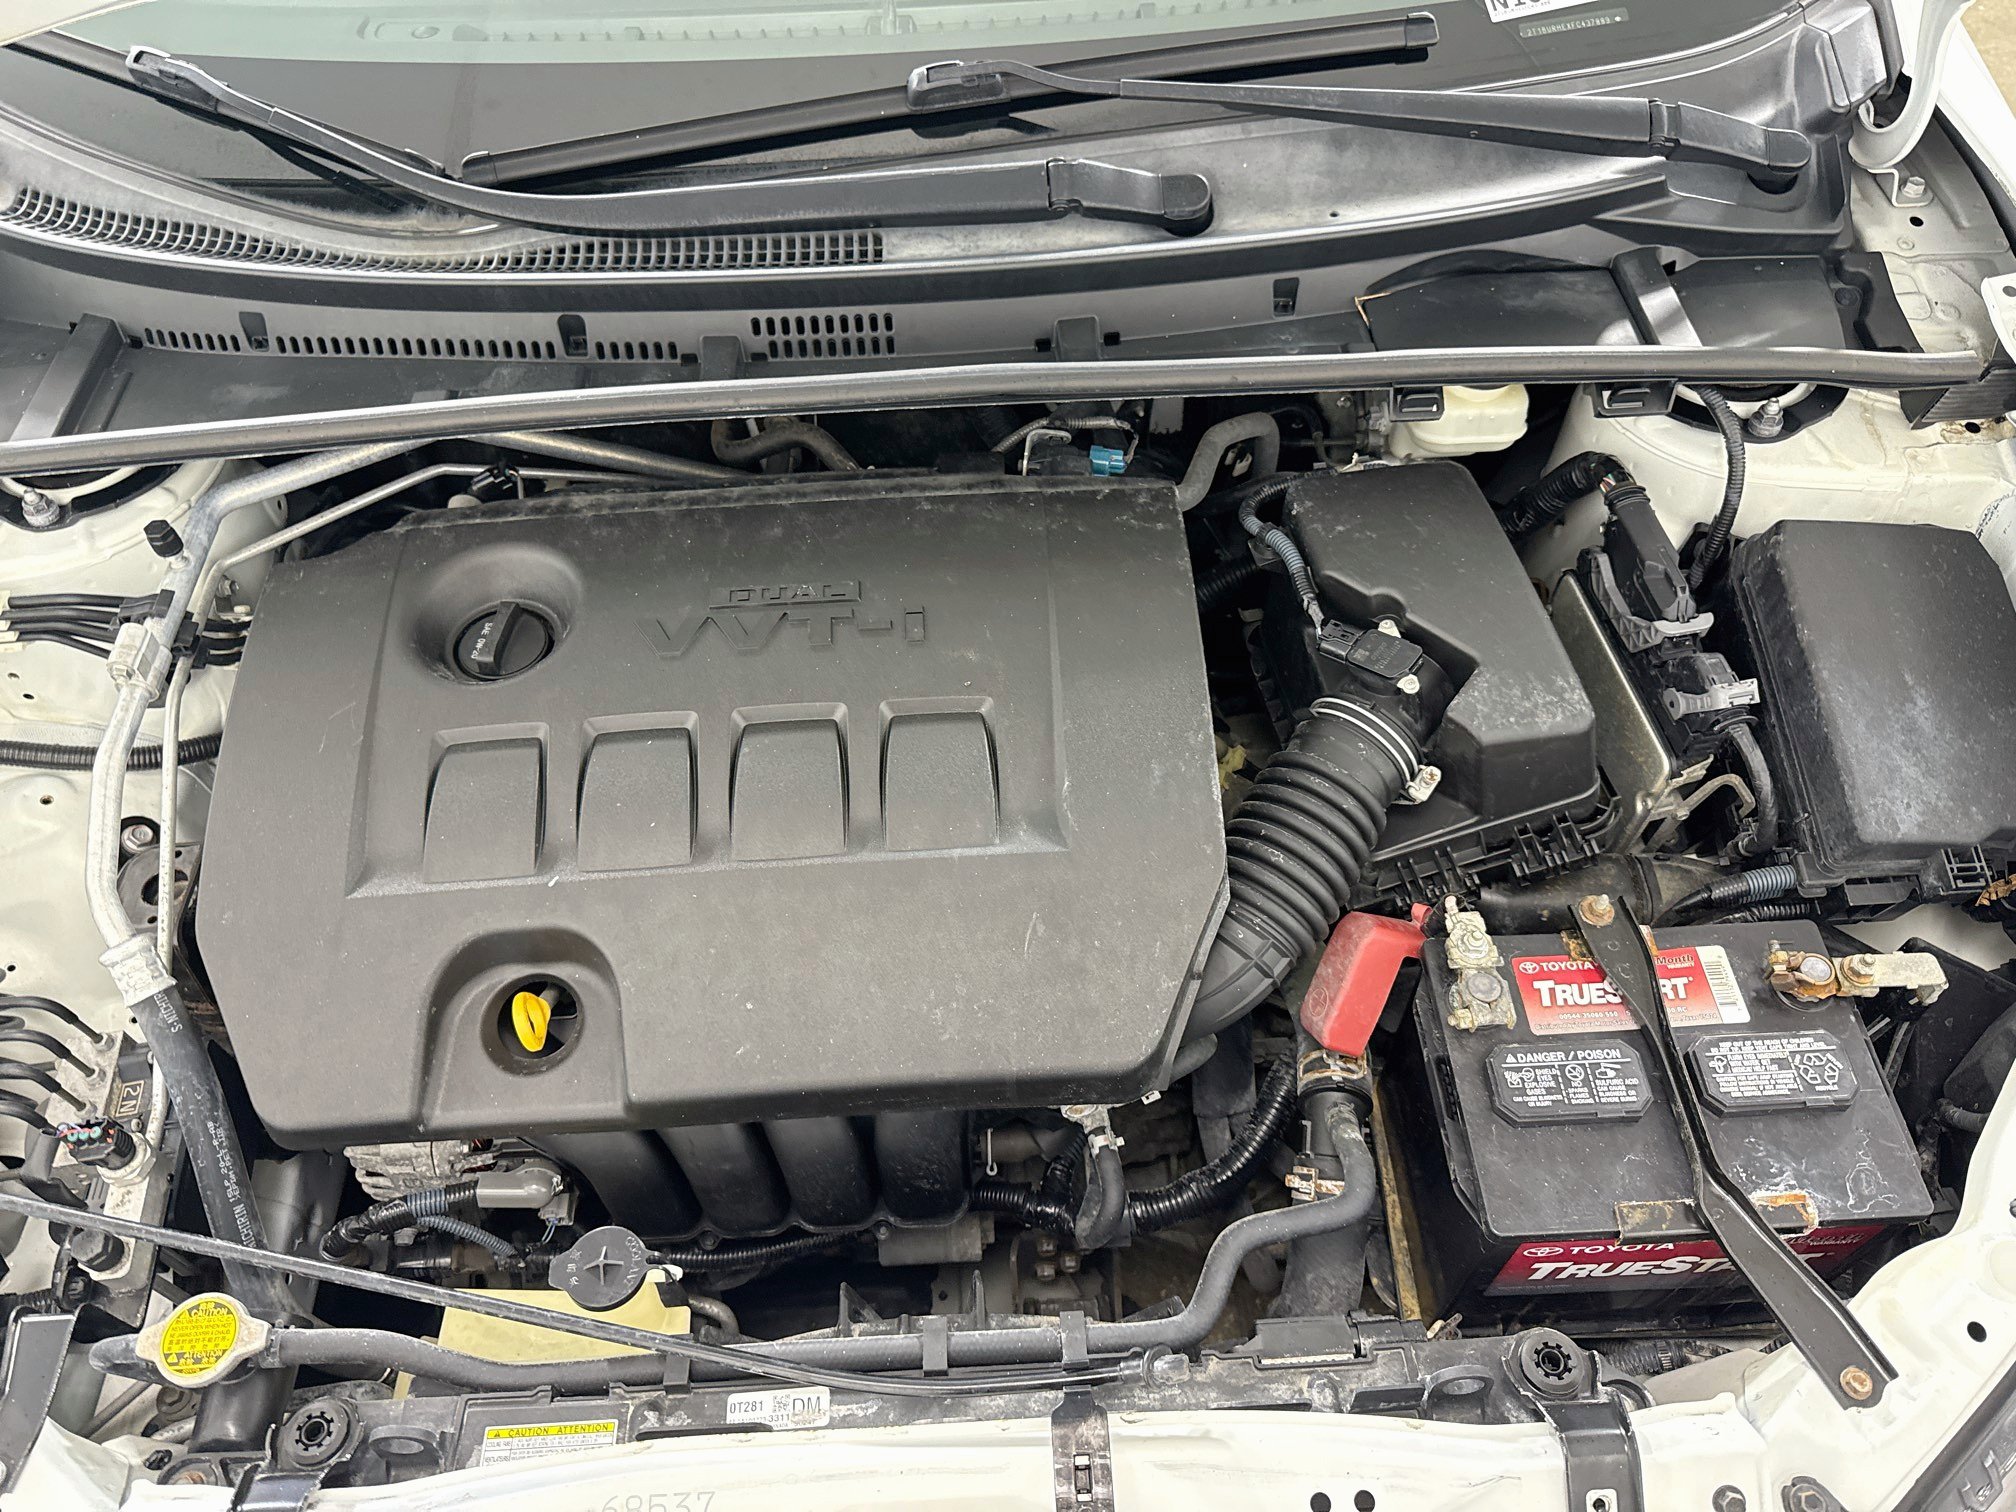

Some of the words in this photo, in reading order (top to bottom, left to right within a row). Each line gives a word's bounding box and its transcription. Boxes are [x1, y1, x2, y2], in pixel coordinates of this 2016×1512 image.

[729, 584, 846, 602] DUAL
[481, 622, 494, 636] SAE
[1540, 961, 1595, 971] TOYOTA
[1656, 953, 1694, 966] Month
[1533, 976, 1690, 1007] TRUESRT
[1517, 1051, 1565, 1062] DANGER
[1568, 1051, 1575, 1060] /
[1576, 1049, 1621, 1060] POISON
[120, 1085, 140, 1112] 2N
[1569, 1242, 1676, 1256] TOYOTA
[191, 1308, 228, 1318] CAUTION
[793, 1396, 821, 1415] DM
[508, 1427, 549, 1438] CAUTION
[556, 1423, 609, 1434] ATTENTION
